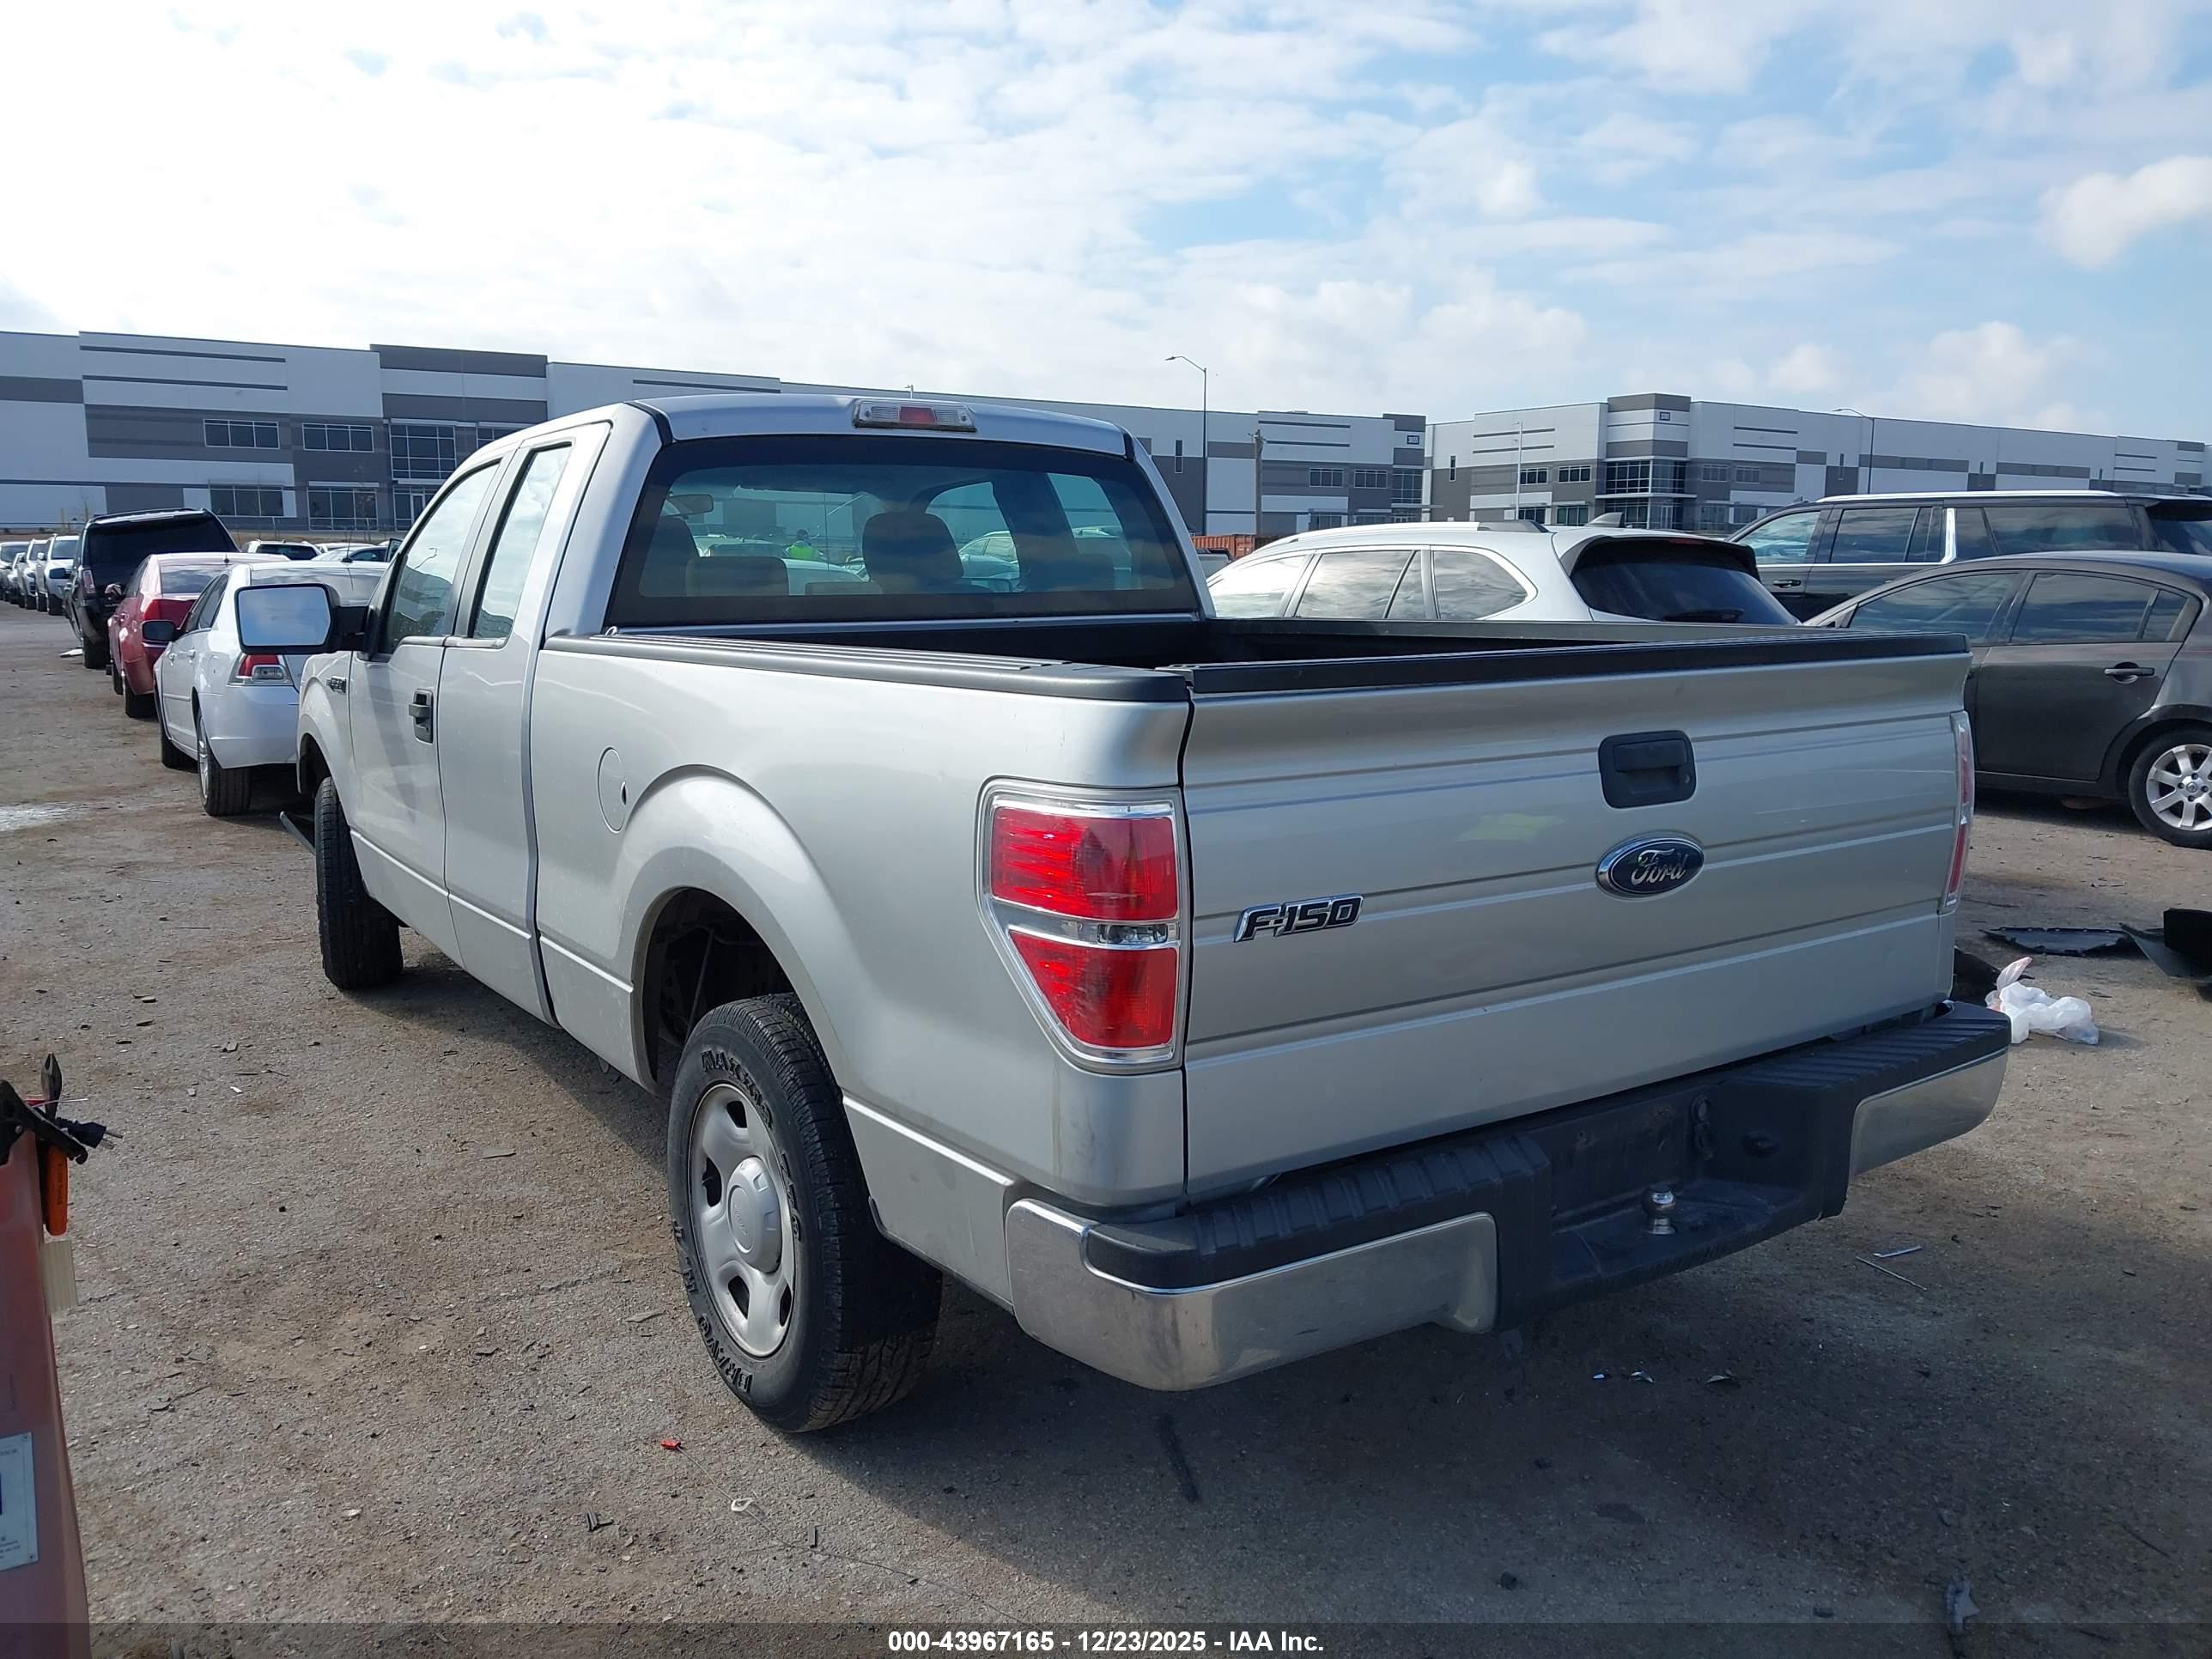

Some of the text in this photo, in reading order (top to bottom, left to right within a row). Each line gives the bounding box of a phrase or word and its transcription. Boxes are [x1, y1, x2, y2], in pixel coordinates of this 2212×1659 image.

[1631, 848, 1690, 886] Ford
[1234, 893, 1364, 943] F-150
[699, 1314, 753, 1394] BRAVO
